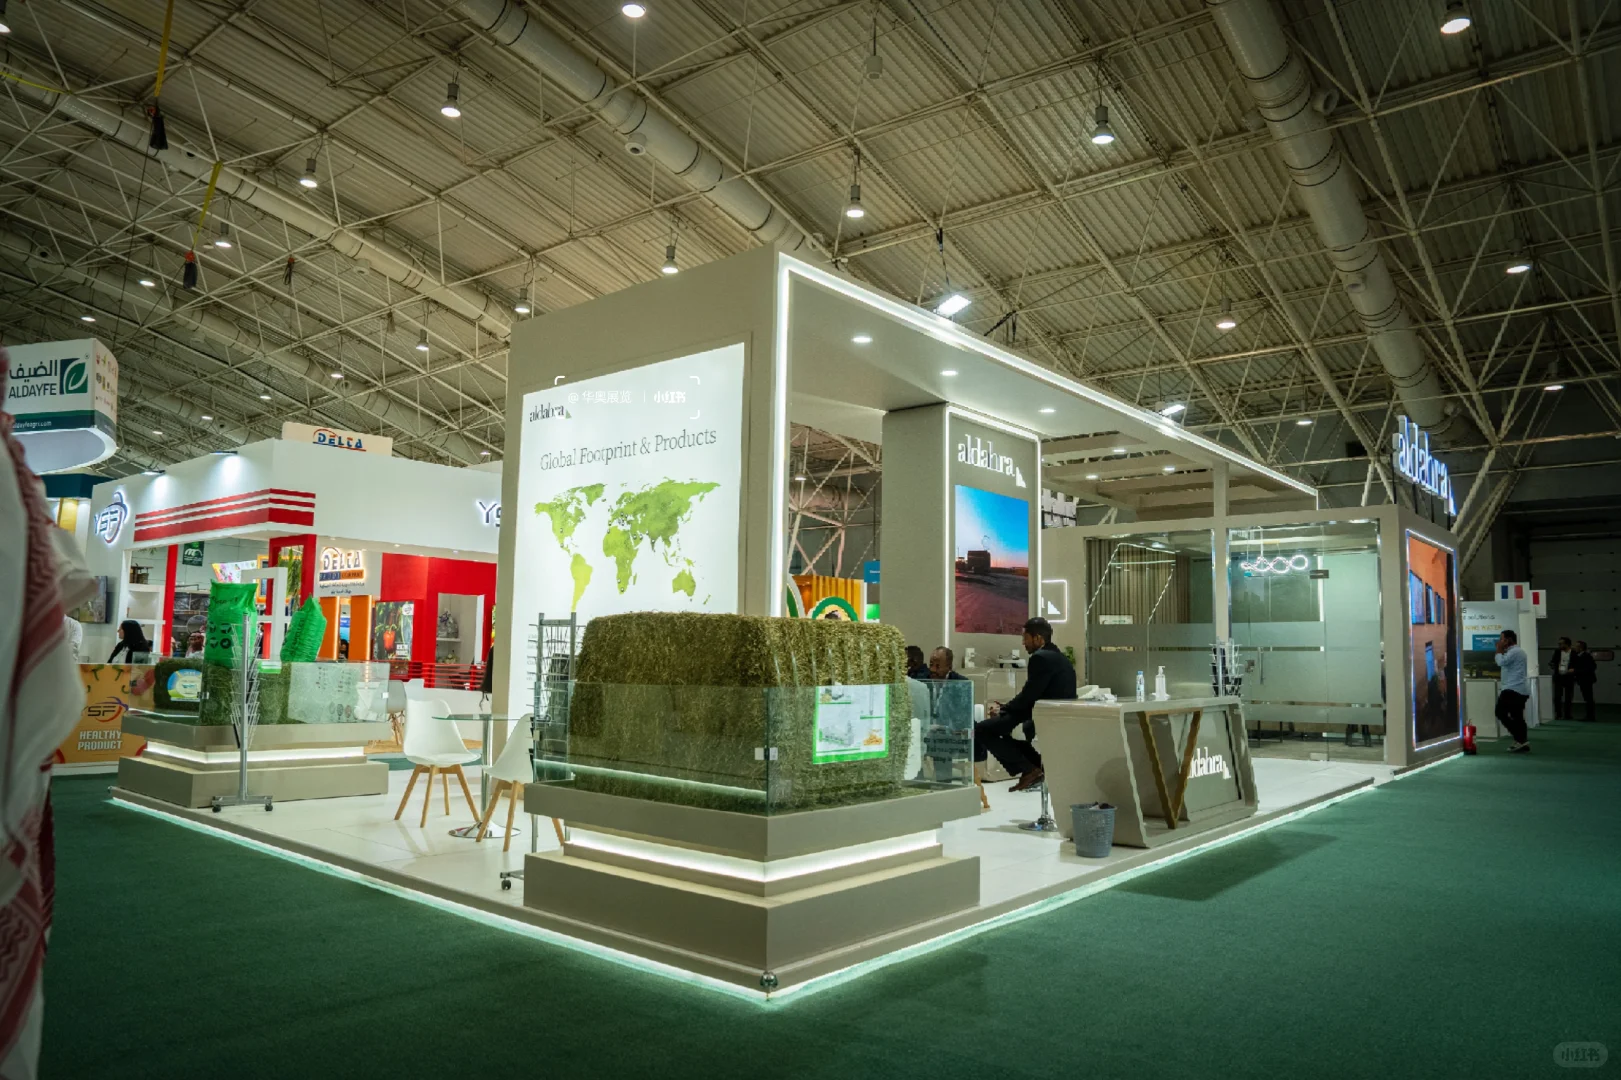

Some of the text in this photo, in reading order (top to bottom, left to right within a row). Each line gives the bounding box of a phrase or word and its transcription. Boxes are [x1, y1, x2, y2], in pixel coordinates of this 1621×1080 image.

[9, 360, 57, 382] الضيف
[8, 383, 57, 398] ALDAYFE
[318, 432, 363, 448] DELTA
[540, 429, 717, 471] Global Footprint & Products
[957, 433, 1015, 477] aldahra
[1393, 415, 1448, 500] aldahra
[323, 551, 361, 571] DELTA
[79, 730, 122, 740] HEALTHY
[77, 741, 123, 751] PRODUCT
[1187, 747, 1223, 779] ldahra
